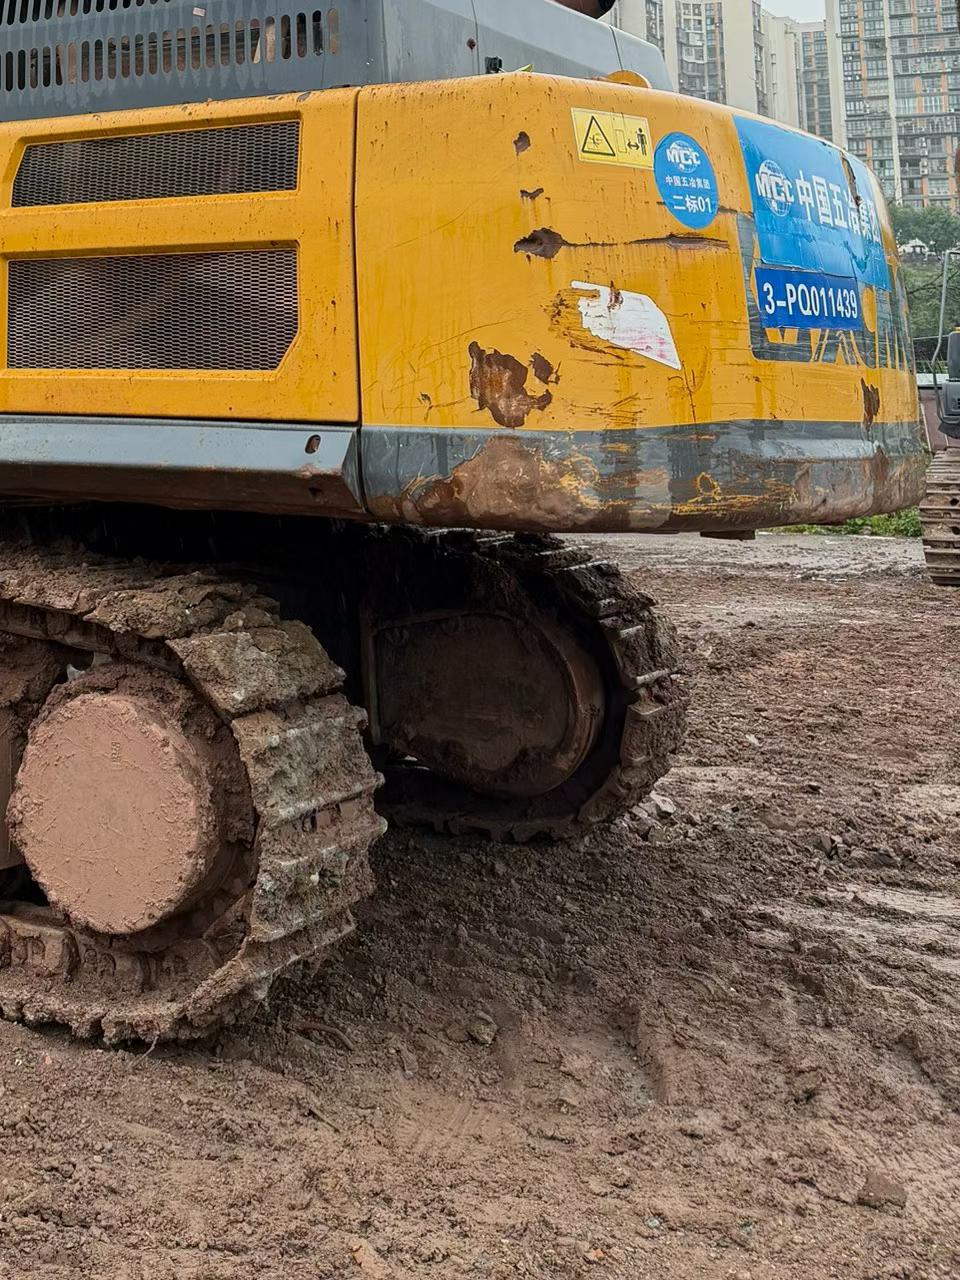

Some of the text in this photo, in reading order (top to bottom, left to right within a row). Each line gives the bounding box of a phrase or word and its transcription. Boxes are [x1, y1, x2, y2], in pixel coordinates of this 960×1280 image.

[666, 149, 700, 164] MCC
[665, 175, 710, 189] 中国五冶集团
[755, 173, 795, 204] MCC
[673, 194, 712, 213] 二标01
[763, 282, 858, 319] 3-PQ011439
